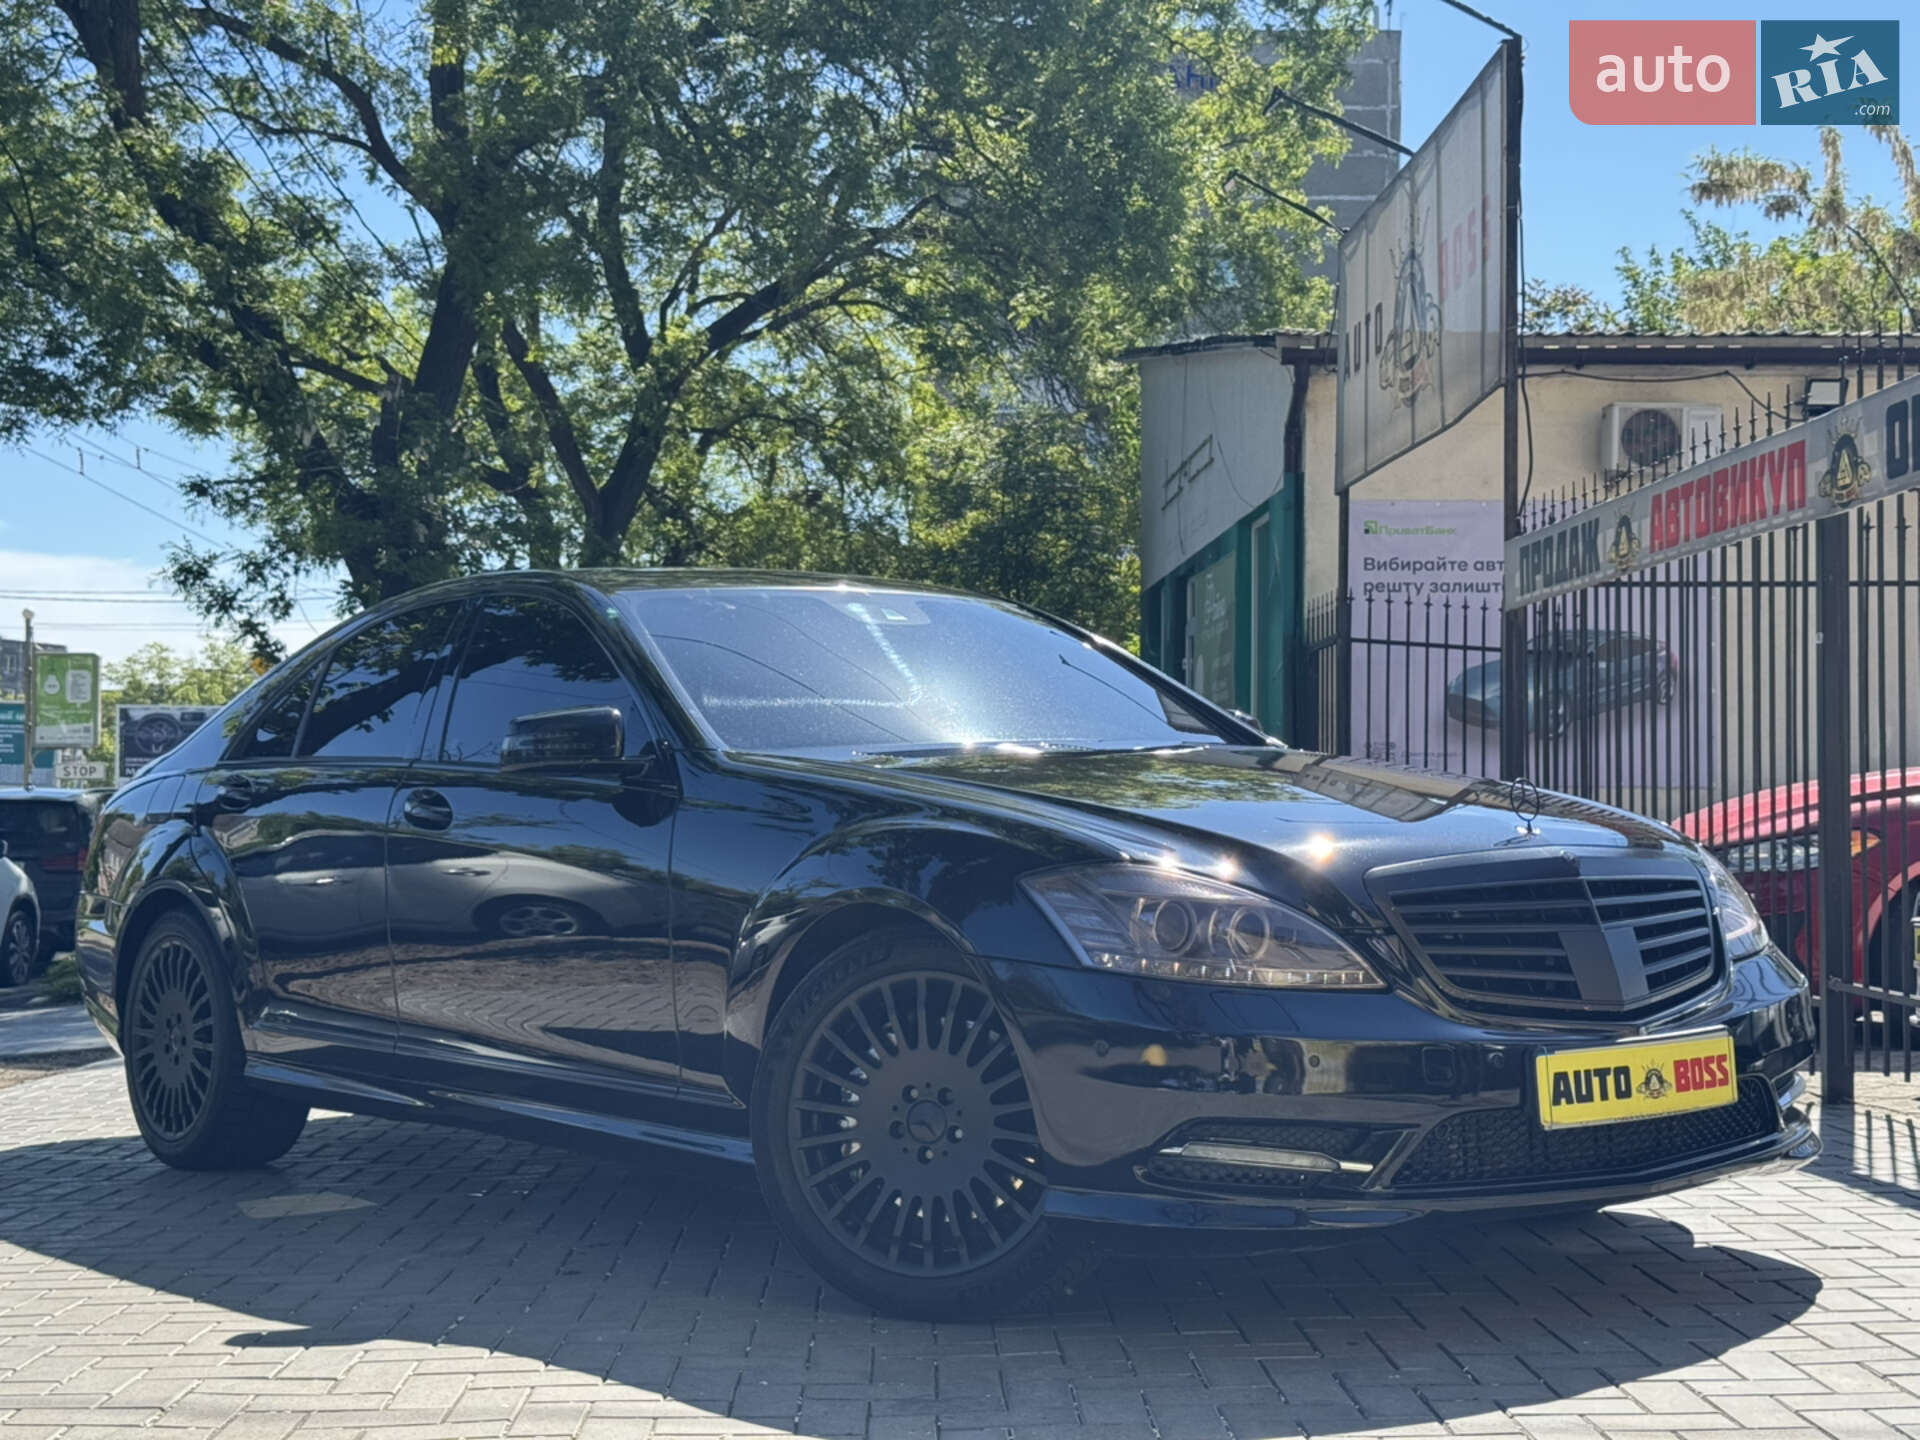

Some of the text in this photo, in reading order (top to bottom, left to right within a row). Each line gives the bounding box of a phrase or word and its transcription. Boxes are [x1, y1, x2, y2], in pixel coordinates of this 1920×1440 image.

[1519, 517, 1601, 597] ПРОДАЖ
[1649, 440, 1807, 555] АВТОВИКУП
[1363, 557, 1469, 575] Вибирайте
[1363, 581, 1424, 596] решту
[63, 765, 98, 777] STOP
[1552, 1054, 1729, 1106] AUTO BOSS
